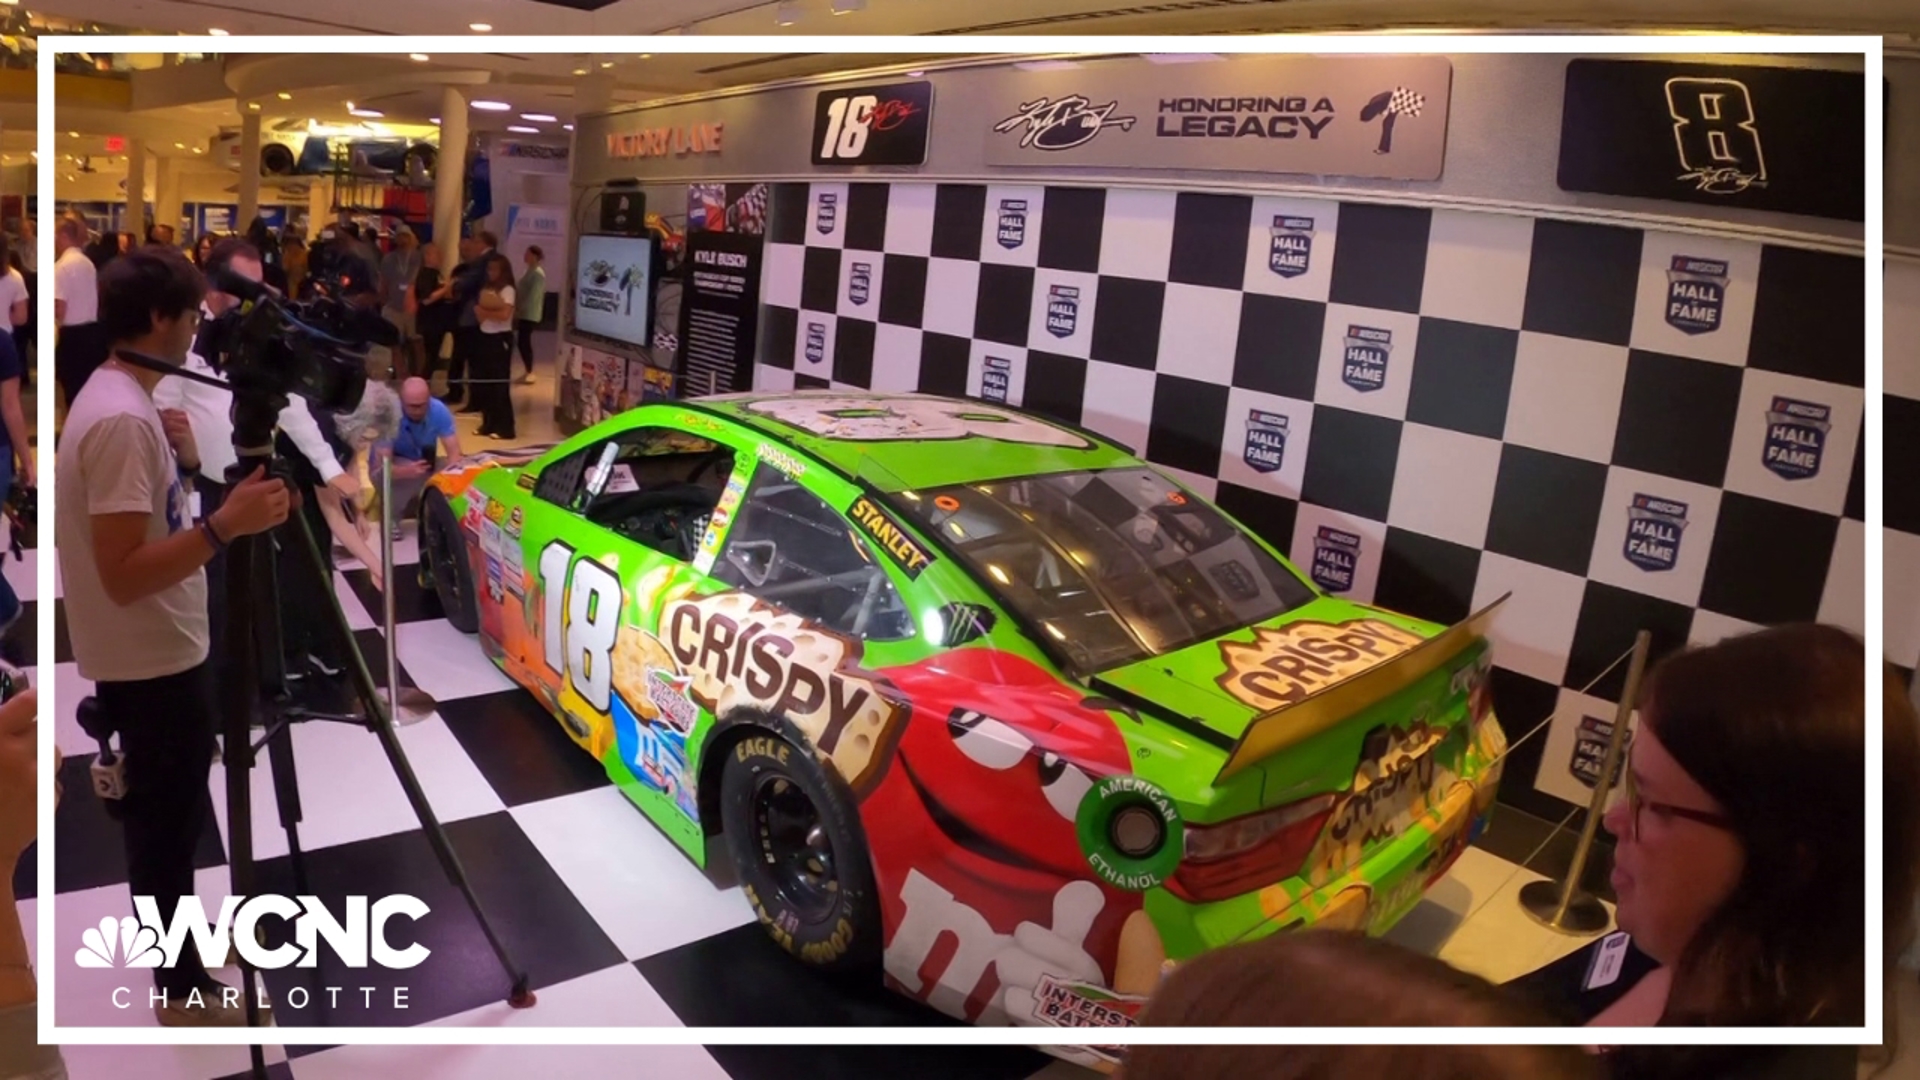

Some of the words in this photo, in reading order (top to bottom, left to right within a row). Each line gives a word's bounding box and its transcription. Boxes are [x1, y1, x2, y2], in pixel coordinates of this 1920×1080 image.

[1158, 97, 1308, 114] HONORING
[1311, 97, 1334, 113] A
[820, 95, 877, 159] 18
[1156, 115, 1334, 140] LEGACY
[1664, 77, 1767, 181] 8
[607, 127, 672, 161] VICTORY
[674, 121, 724, 158] LANE
[1274, 237, 1307, 252] HALL
[694, 250, 717, 266] KYLE
[717, 253, 747, 268] BUSCH
[1272, 253, 1306, 268] FAME
[1672, 282, 1718, 302] HALL
[1049, 303, 1075, 316] HALL
[1670, 302, 1717, 323] FAME
[1048, 317, 1074, 330] FAME
[1347, 348, 1383, 364] HALL
[1345, 366, 1382, 382] FAME
[1249, 431, 1281, 448] HALL
[1771, 425, 1819, 447] HALL
[1247, 446, 1280, 464] FAME
[1768, 446, 1816, 468] FAME
[851, 497, 925, 569] STANLEY
[1632, 520, 1675, 542] HALL
[1317, 548, 1351, 566] HALL
[1628, 540, 1673, 562] FAME
[1315, 565, 1349, 584] FAME
[539, 539, 622, 714] 18
[1239, 623, 1404, 701] CRISPY
[671, 603, 870, 756] CRISPY
[736, 738, 790, 767] EAGLE
[1099, 778, 1177, 822] AMERICAN
[1088, 852, 1161, 889] ETHANOL
